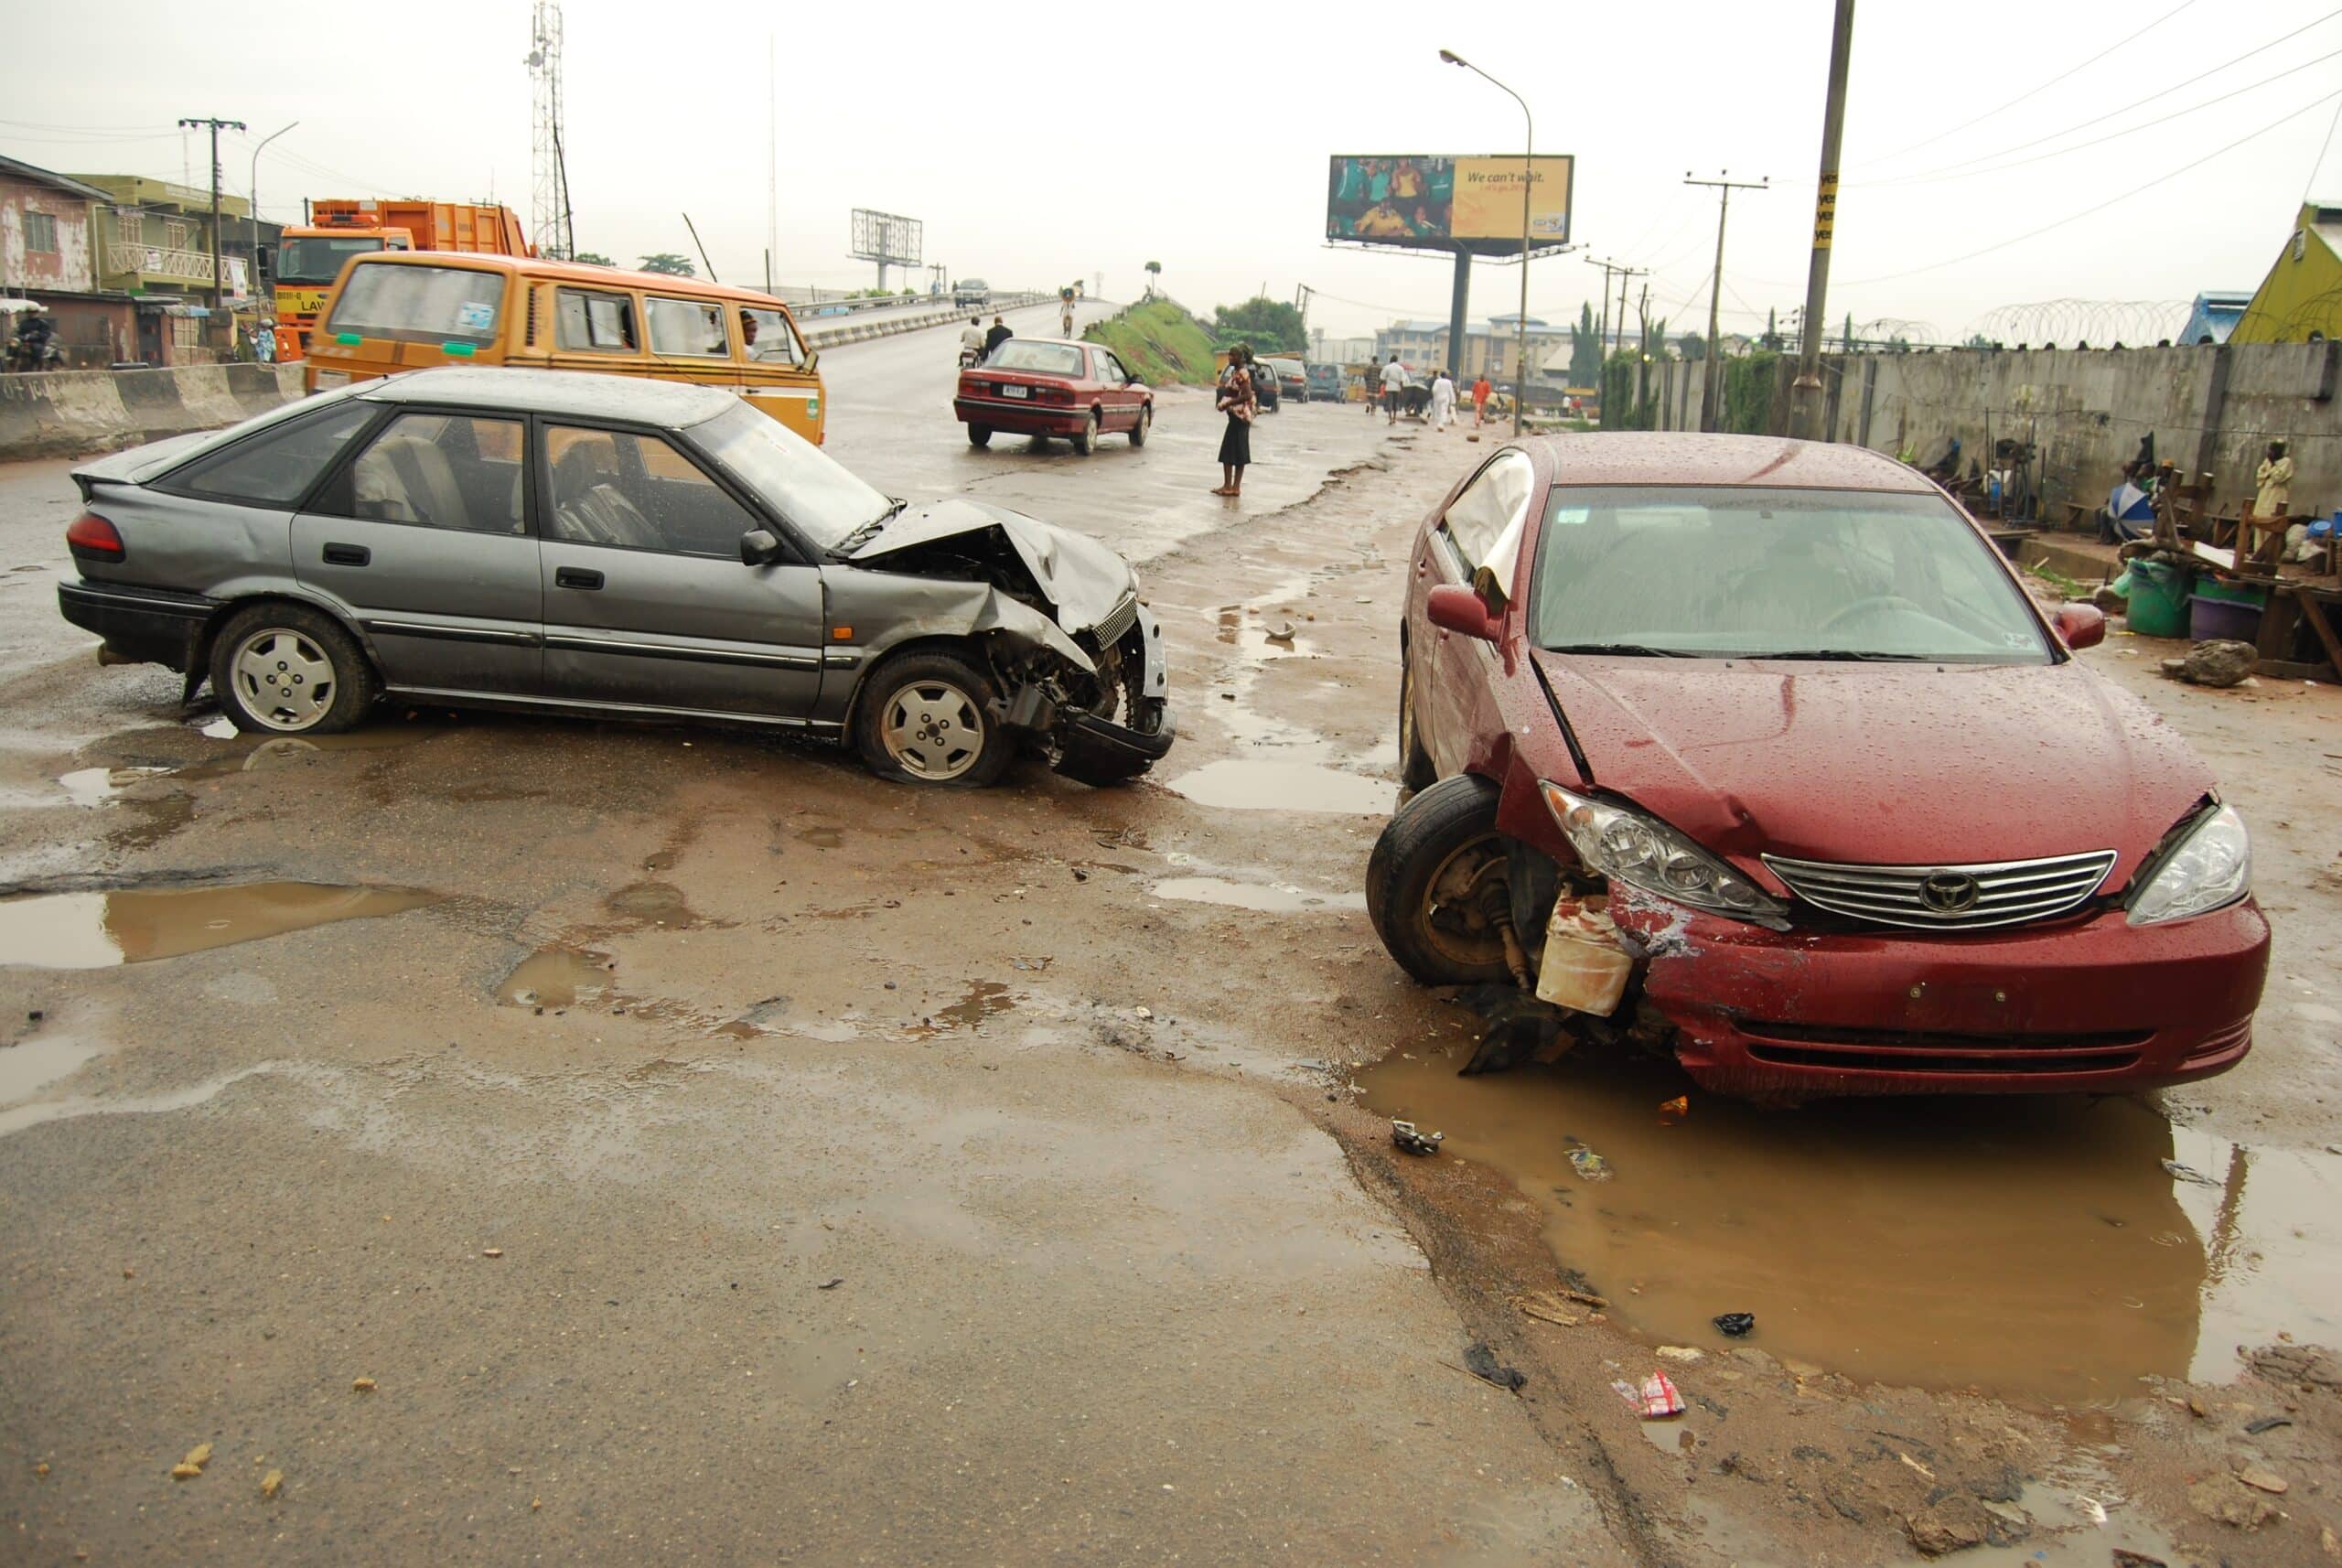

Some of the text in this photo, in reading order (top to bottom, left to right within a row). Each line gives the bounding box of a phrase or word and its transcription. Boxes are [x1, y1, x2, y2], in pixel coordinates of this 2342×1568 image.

[1467, 171, 1545, 183] We can't wit.
